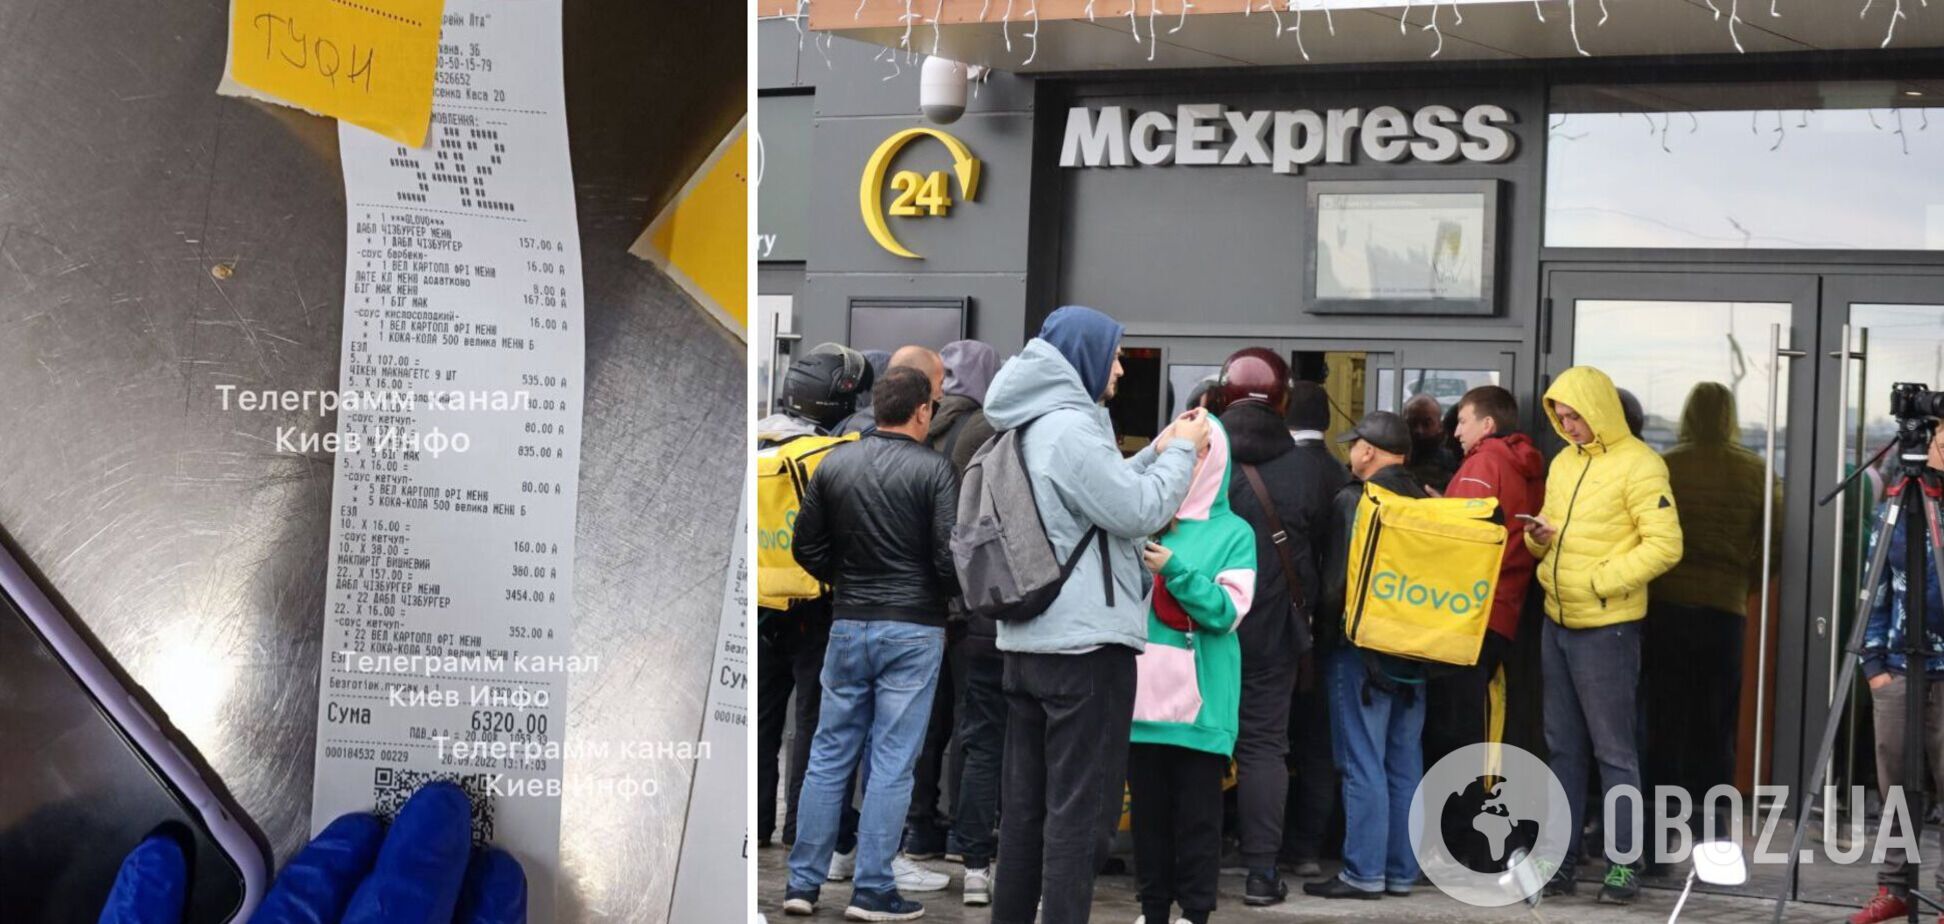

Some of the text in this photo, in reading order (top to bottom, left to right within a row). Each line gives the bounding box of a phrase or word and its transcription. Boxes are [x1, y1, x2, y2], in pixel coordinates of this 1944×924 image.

[436, 56, 492, 72] 0-50-15-79
[432, 88, 506, 102] сенко Каса 20
[1060, 104, 1514, 174] McExpress
[889, 170, 951, 216] 24
[356, 223, 376, 234] ДАБЛ
[392, 236, 412, 247] ДАБЛ
[520, 238, 551, 250] 157.00
[392, 261, 408, 271] ВЕЛ
[527, 261, 554, 274] 16.00
[376, 284, 392, 294] МАК
[412, 298, 428, 308] МАК
[524, 294, 556, 307] 167.00
[390, 320, 406, 330] ВЕЛ
[530, 318, 556, 330] 16.00
[389, 332, 437, 345] КОКА-КОЛА
[442, 334, 458, 345] 500
[378, 355, 409, 366] 107.00
[350, 366, 376, 376] ЧІКЕН
[376, 378, 402, 389] 16.00
[522, 374, 556, 386] 535.00
[525, 422, 552, 434] 80.00
[518, 446, 552, 458] 835.00
[372, 460, 398, 472] 16.00
[380, 484, 396, 495] ВЕЛ
[522, 482, 549, 494] 80.00
[379, 496, 428, 508] КОКА-КОЛА
[434, 500, 450, 510] 500
[340, 519, 400, 532] 10. 16.00
[339, 543, 398, 556] 10. 38.00
[514, 542, 546, 554] 160.00
[336, 566, 402, 580] 22. 157.00
[512, 565, 545, 578] 380.00
[336, 579, 358, 590] ДАБЛ
[364, 580, 412, 593] ЧІЗБУРГЕР
[357, 592, 368, 602] 22
[374, 592, 396, 604] ДАБЛ
[505, 589, 544, 602] 3454.00
[1372, 571, 1470, 614] Glovo
[334, 604, 395, 616] 22. 16.00
[354, 630, 366, 640] 22
[372, 630, 388, 640] ВЕЛ
[509, 626, 542, 638] 352.00
[354, 641, 366, 652] 22
[426, 645, 442, 656] 500
[725, 641, 748, 655] Безг
[328, 702, 371, 724] Сума
[714, 710, 748, 728] 000184
[472, 710, 547, 734] 6320.00
[325, 746, 408, 762] 000184532 00229
